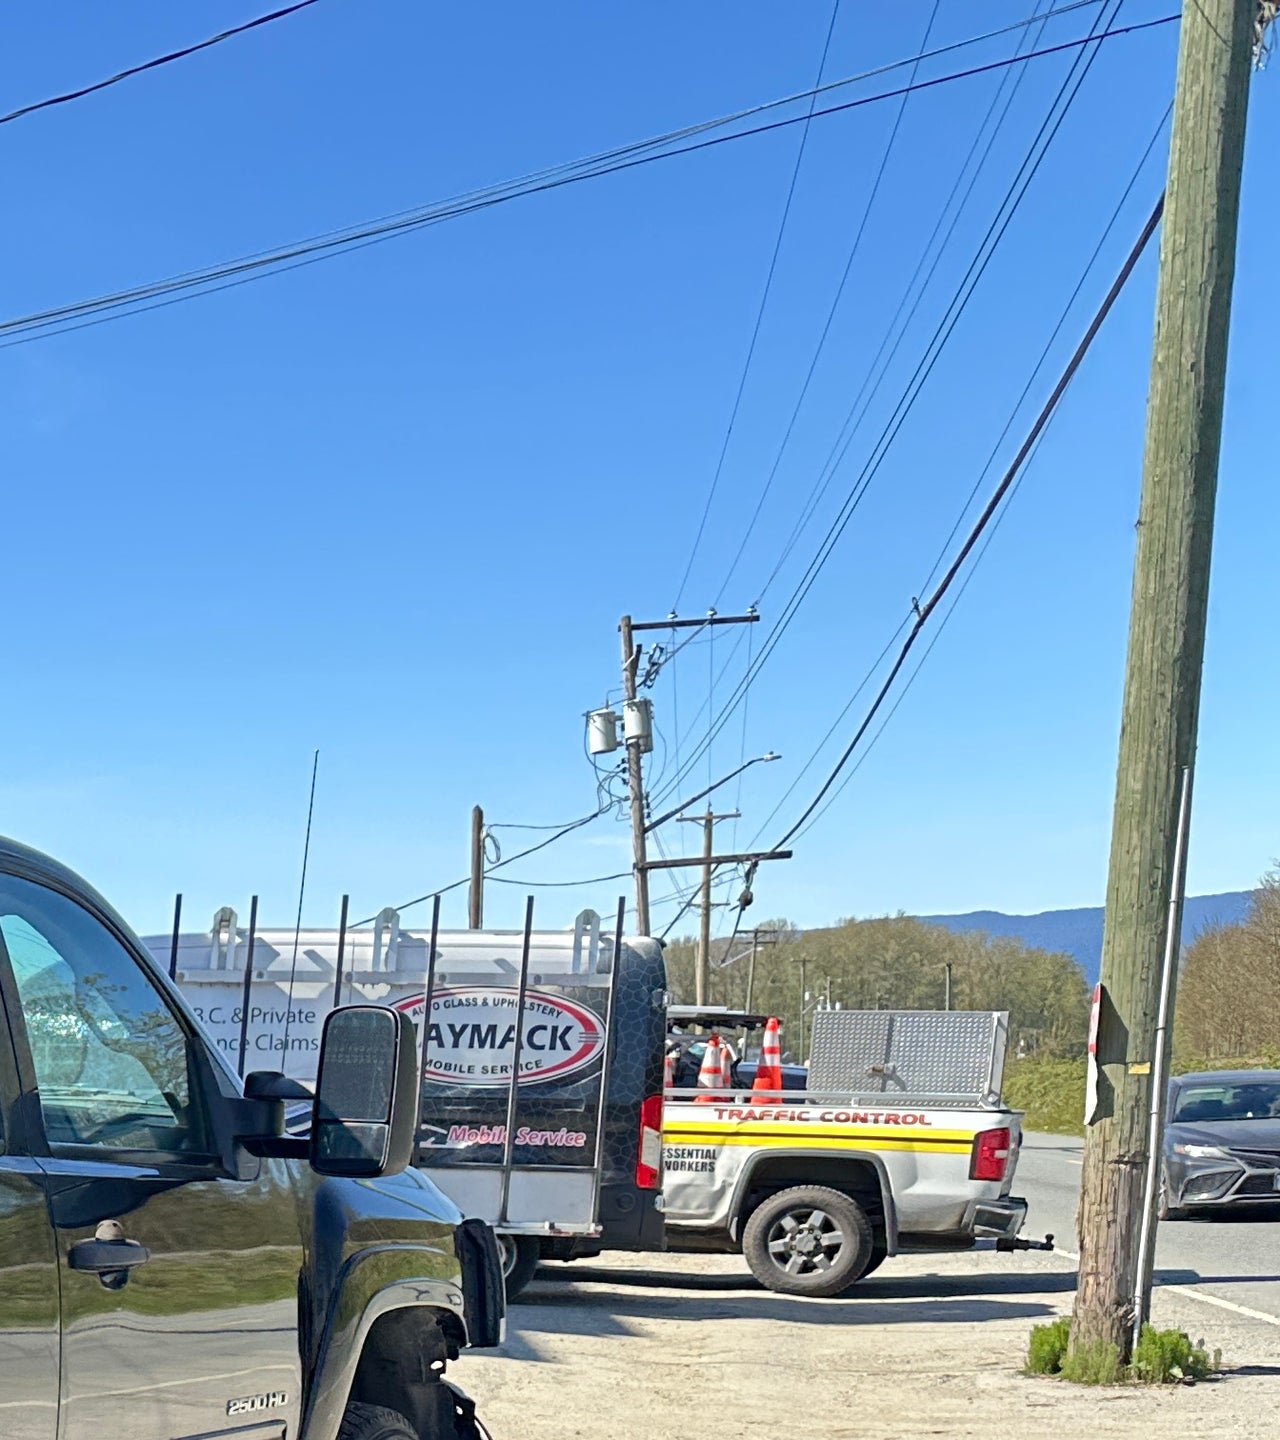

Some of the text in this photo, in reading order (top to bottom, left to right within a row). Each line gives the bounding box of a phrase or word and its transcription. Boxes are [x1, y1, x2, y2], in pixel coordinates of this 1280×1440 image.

[443, 997, 478, 1009] GLASS
[481, 996, 489, 1007] &
[231, 1007, 243, 1024] &
[251, 1007, 316, 1025] Private
[255, 1033, 319, 1052] Claims
[414, 1022, 575, 1051] AYMACK
[713, 1108, 932, 1126] TRAFFIC CONTROL
[515, 1126, 586, 1147] Service
